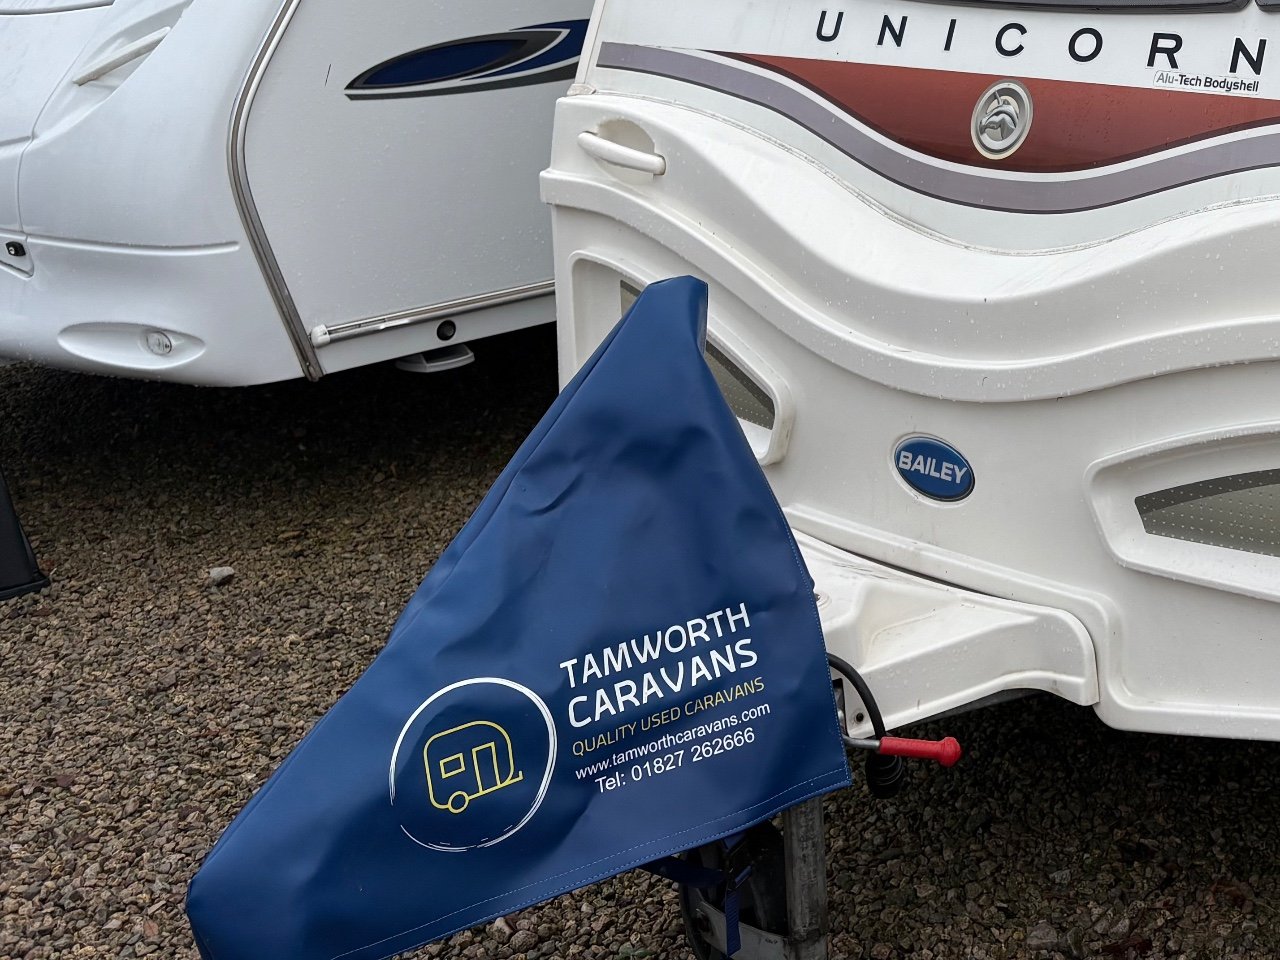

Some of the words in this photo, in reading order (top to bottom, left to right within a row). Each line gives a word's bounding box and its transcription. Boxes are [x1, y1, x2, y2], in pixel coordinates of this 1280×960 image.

[815, 10, 1267, 76] UNICORN
[1156, 72, 1201, 87] Alu-Tech
[1203, 76, 1260, 92] Bodyshell
[898, 450, 968, 484] BAILEY
[559, 602, 751, 688] TAMWORTH
[568, 638, 758, 728] CARAVANS
[572, 722, 637, 757] QUALITY
[641, 707, 681, 731] USED
[684, 676, 765, 716] CARAVANS
[575, 703, 771, 780] www.tamworthcaravans.com
[595, 771, 626, 793] Tel:
[631, 749, 685, 781] 01827
[690, 727, 755, 762] 262666
